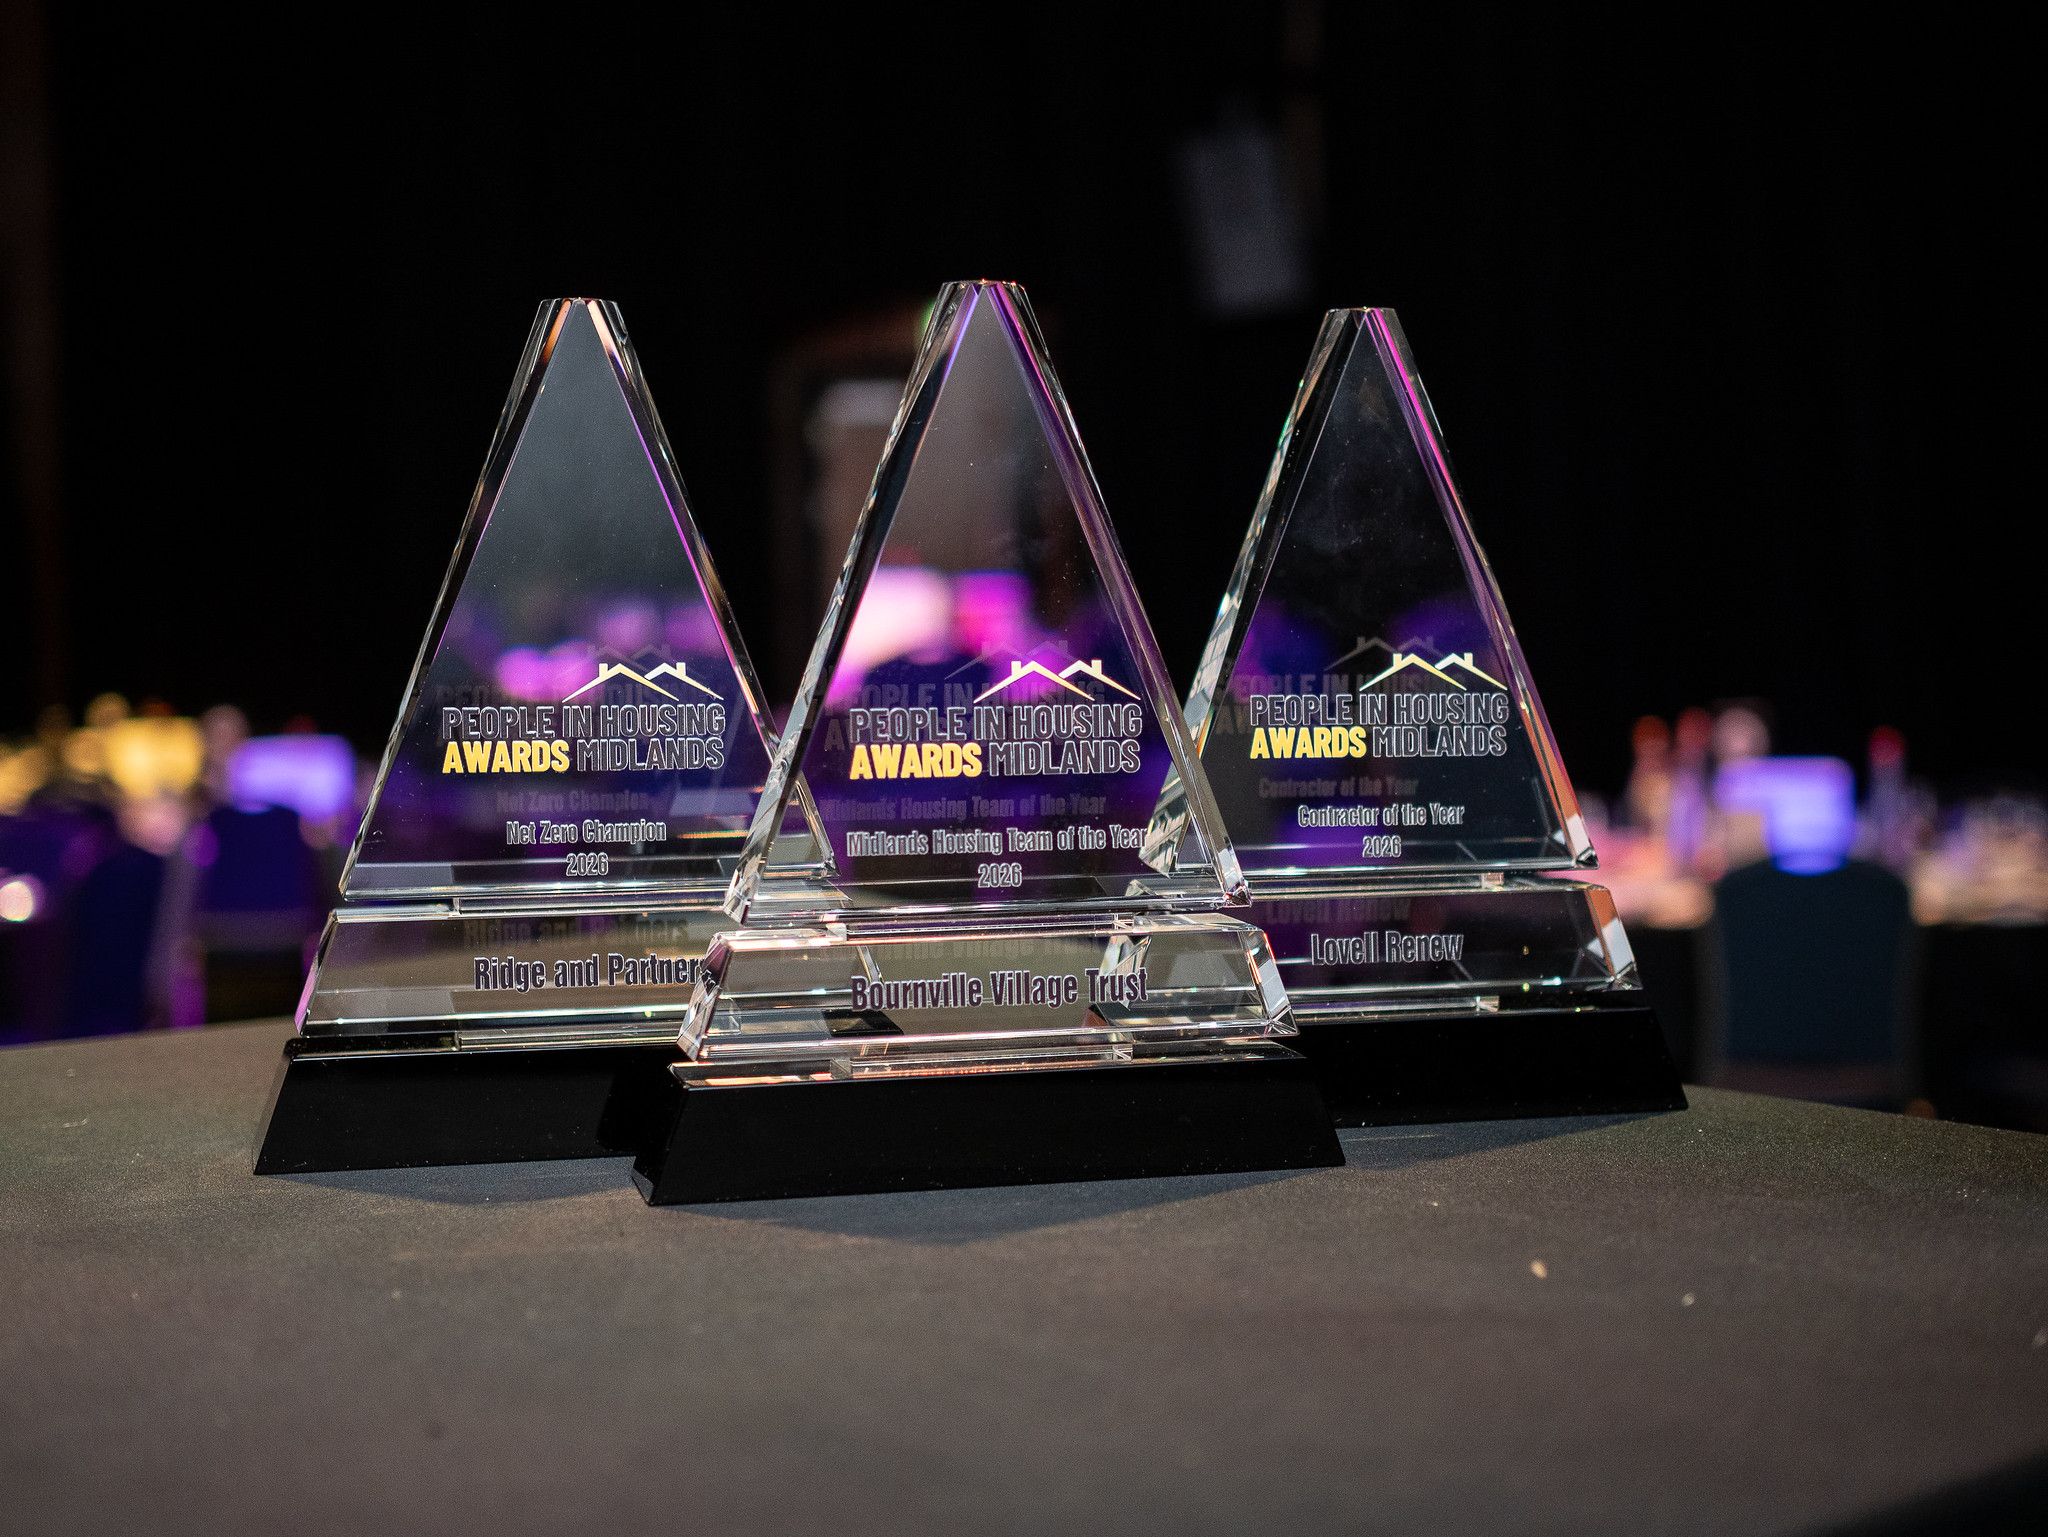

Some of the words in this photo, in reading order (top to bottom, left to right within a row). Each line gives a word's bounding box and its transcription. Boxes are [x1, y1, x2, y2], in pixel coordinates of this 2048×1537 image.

[442, 705, 555, 739] PEOPLE
[562, 704, 592, 738] IN
[600, 703, 726, 737] HOUSING
[850, 707, 966, 743] PEOPLE
[974, 706, 1005, 740] IN
[1013, 704, 1142, 739] HOUSING
[1250, 695, 1353, 726] PEOPLE
[1359, 694, 1388, 725] IN
[1395, 693, 1509, 725] HOUSING
[442, 740, 569, 773] AWARDS
[577, 738, 724, 771] MIDLANDS
[1250, 726, 1367, 759] AWARDS
[1373, 725, 1507, 758] MIDLANDS
[850, 743, 982, 779] AWARDS
[989, 740, 1140, 776] MIDLANDS
[506, 821, 536, 845] Net
[540, 820, 578, 843] Zero
[582, 819, 667, 845] Champion
[1298, 805, 1379, 827] Contractor
[1383, 804, 1399, 826] of
[1401, 804, 1427, 825] the
[1430, 803, 1465, 825] Year
[847, 831, 928, 857] Midlands
[933, 829, 1003, 855] Housing
[1007, 827, 1053, 851] Team
[1057, 826, 1075, 850] of
[1078, 825, 1106, 849] the
[1109, 824, 1147, 849] Year
[1362, 836, 1401, 858] 2026
[566, 853, 609, 876] 2026
[978, 863, 1022, 888] 2026
[1310, 931, 1378, 965] Lovell
[1385, 930, 1464, 963] Renew
[474, 956, 546, 993] Ridge
[554, 953, 600, 988] and
[607, 953, 705, 986] Partner
[851, 972, 983, 1011] Bournville
[990, 970, 1078, 1008] Village
[1085, 967, 1148, 1002] Trust
